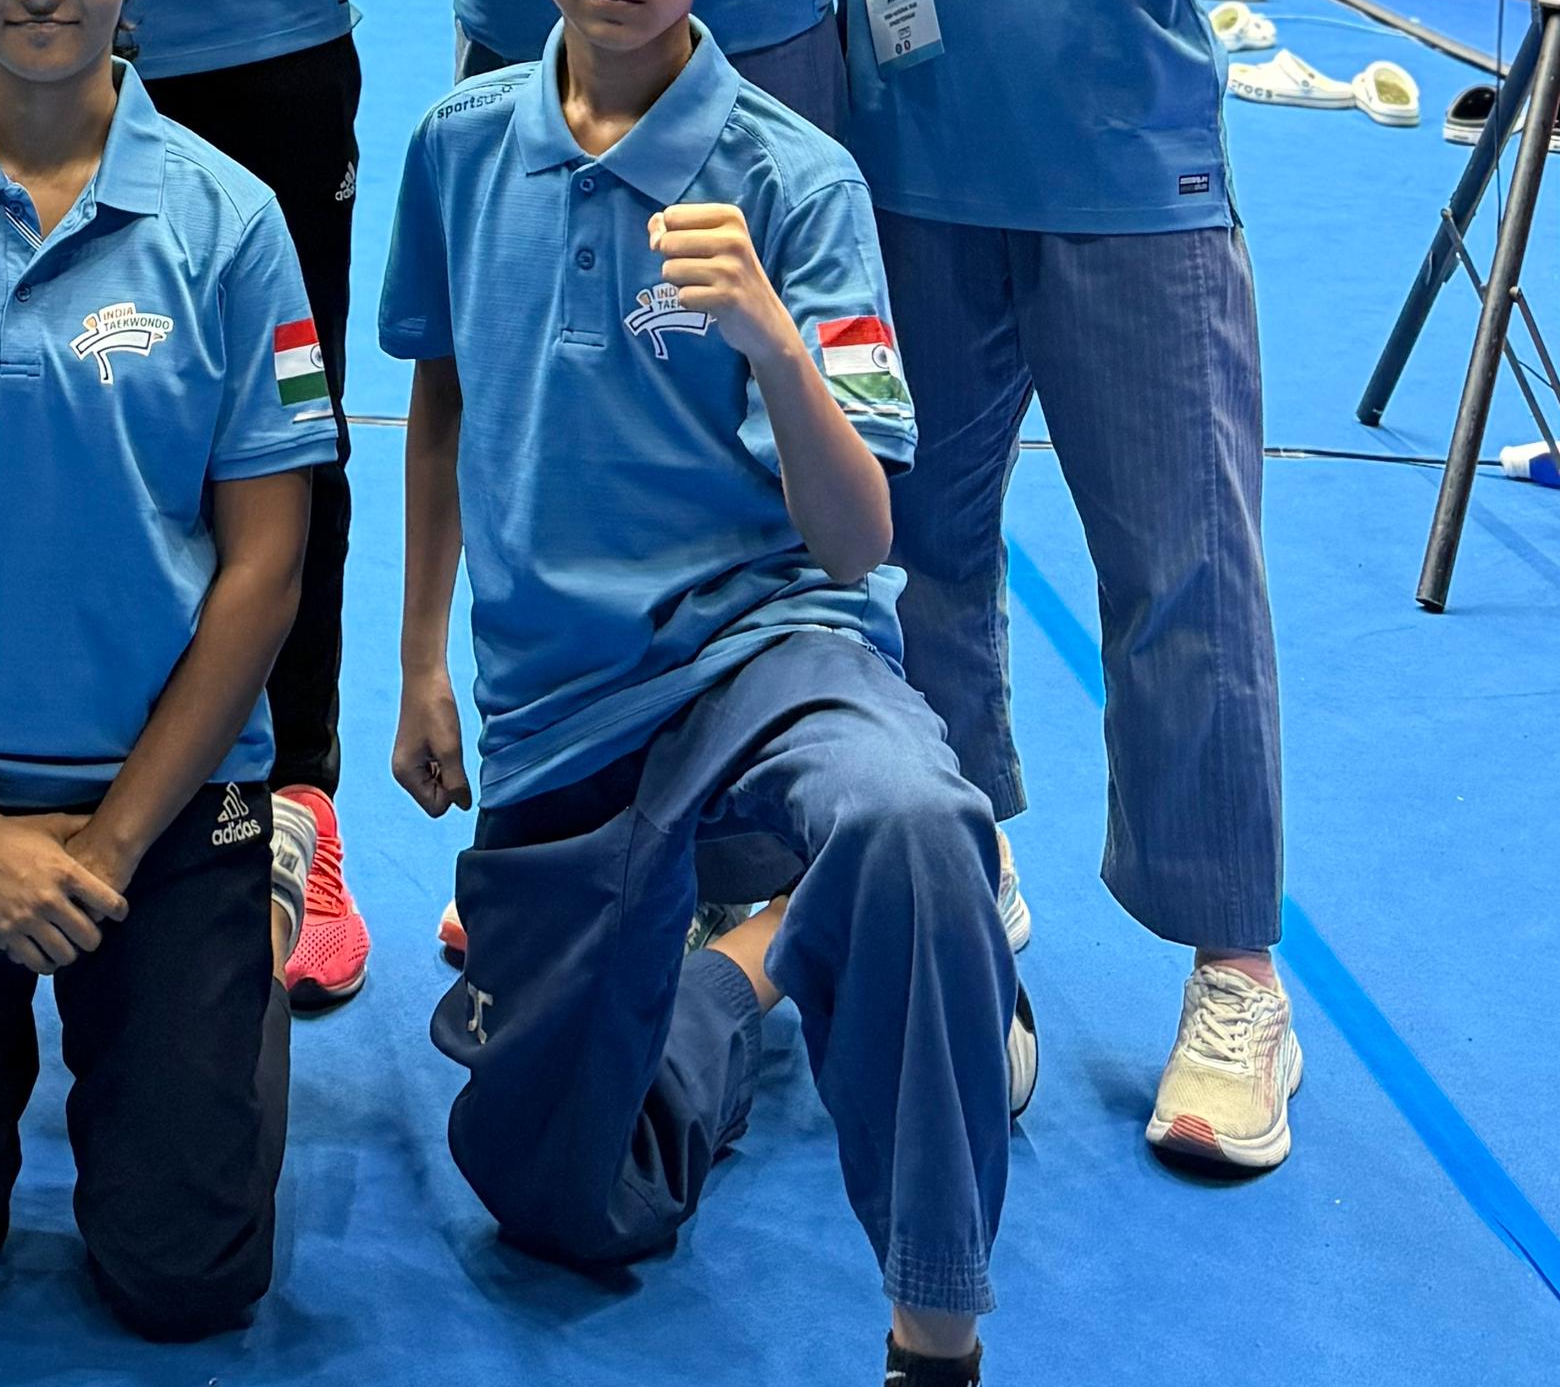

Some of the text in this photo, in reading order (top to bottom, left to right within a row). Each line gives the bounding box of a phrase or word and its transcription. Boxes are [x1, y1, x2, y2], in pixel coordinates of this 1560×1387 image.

[437, 93, 503, 120] sportsun
[103, 307, 134, 321] INDIA
[104, 316, 170, 332] TAEKWONDO
[211, 818, 262, 846] adidas
